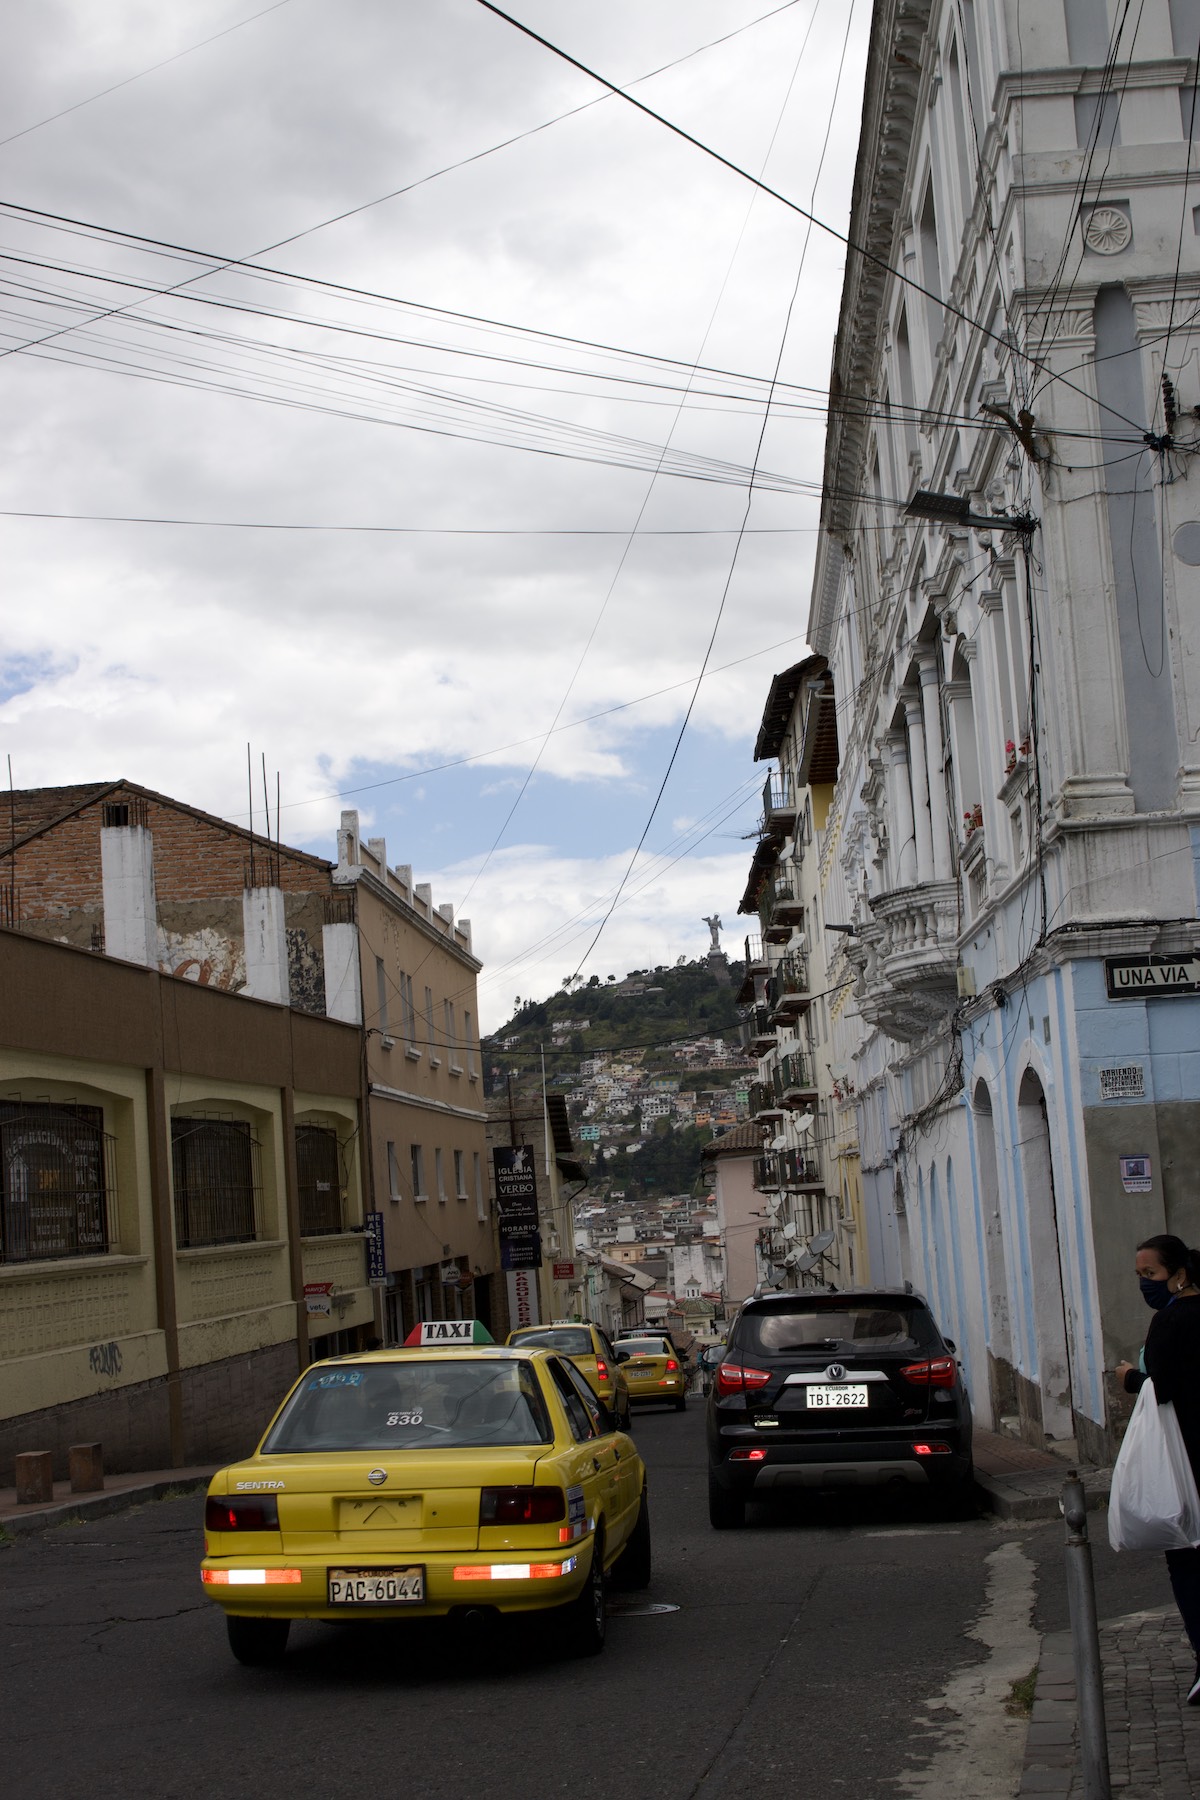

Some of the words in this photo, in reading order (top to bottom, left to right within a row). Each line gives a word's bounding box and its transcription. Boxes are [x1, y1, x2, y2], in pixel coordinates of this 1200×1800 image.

[1119, 968, 1156, 986] UNA
[1159, 966, 1189, 983] VIA
[1101, 1067, 1137, 1077] ARRIENDO
[498, 1173, 533, 1183] CRISTIANA
[500, 1183, 534, 1195] VERBO
[501, 1224, 537, 1233] HORARIO
[367, 1213, 377, 1277] MAERIAL
[374, 1213, 384, 1277] ELECTRICO
[425, 1323, 472, 1339] TAXI
[809, 1393, 866, 1406] TBI-2622
[386, 1415, 424, 1426] 830
[236, 1480, 286, 1490] SENTRA
[331, 1579, 420, 1601] PAC-6044
